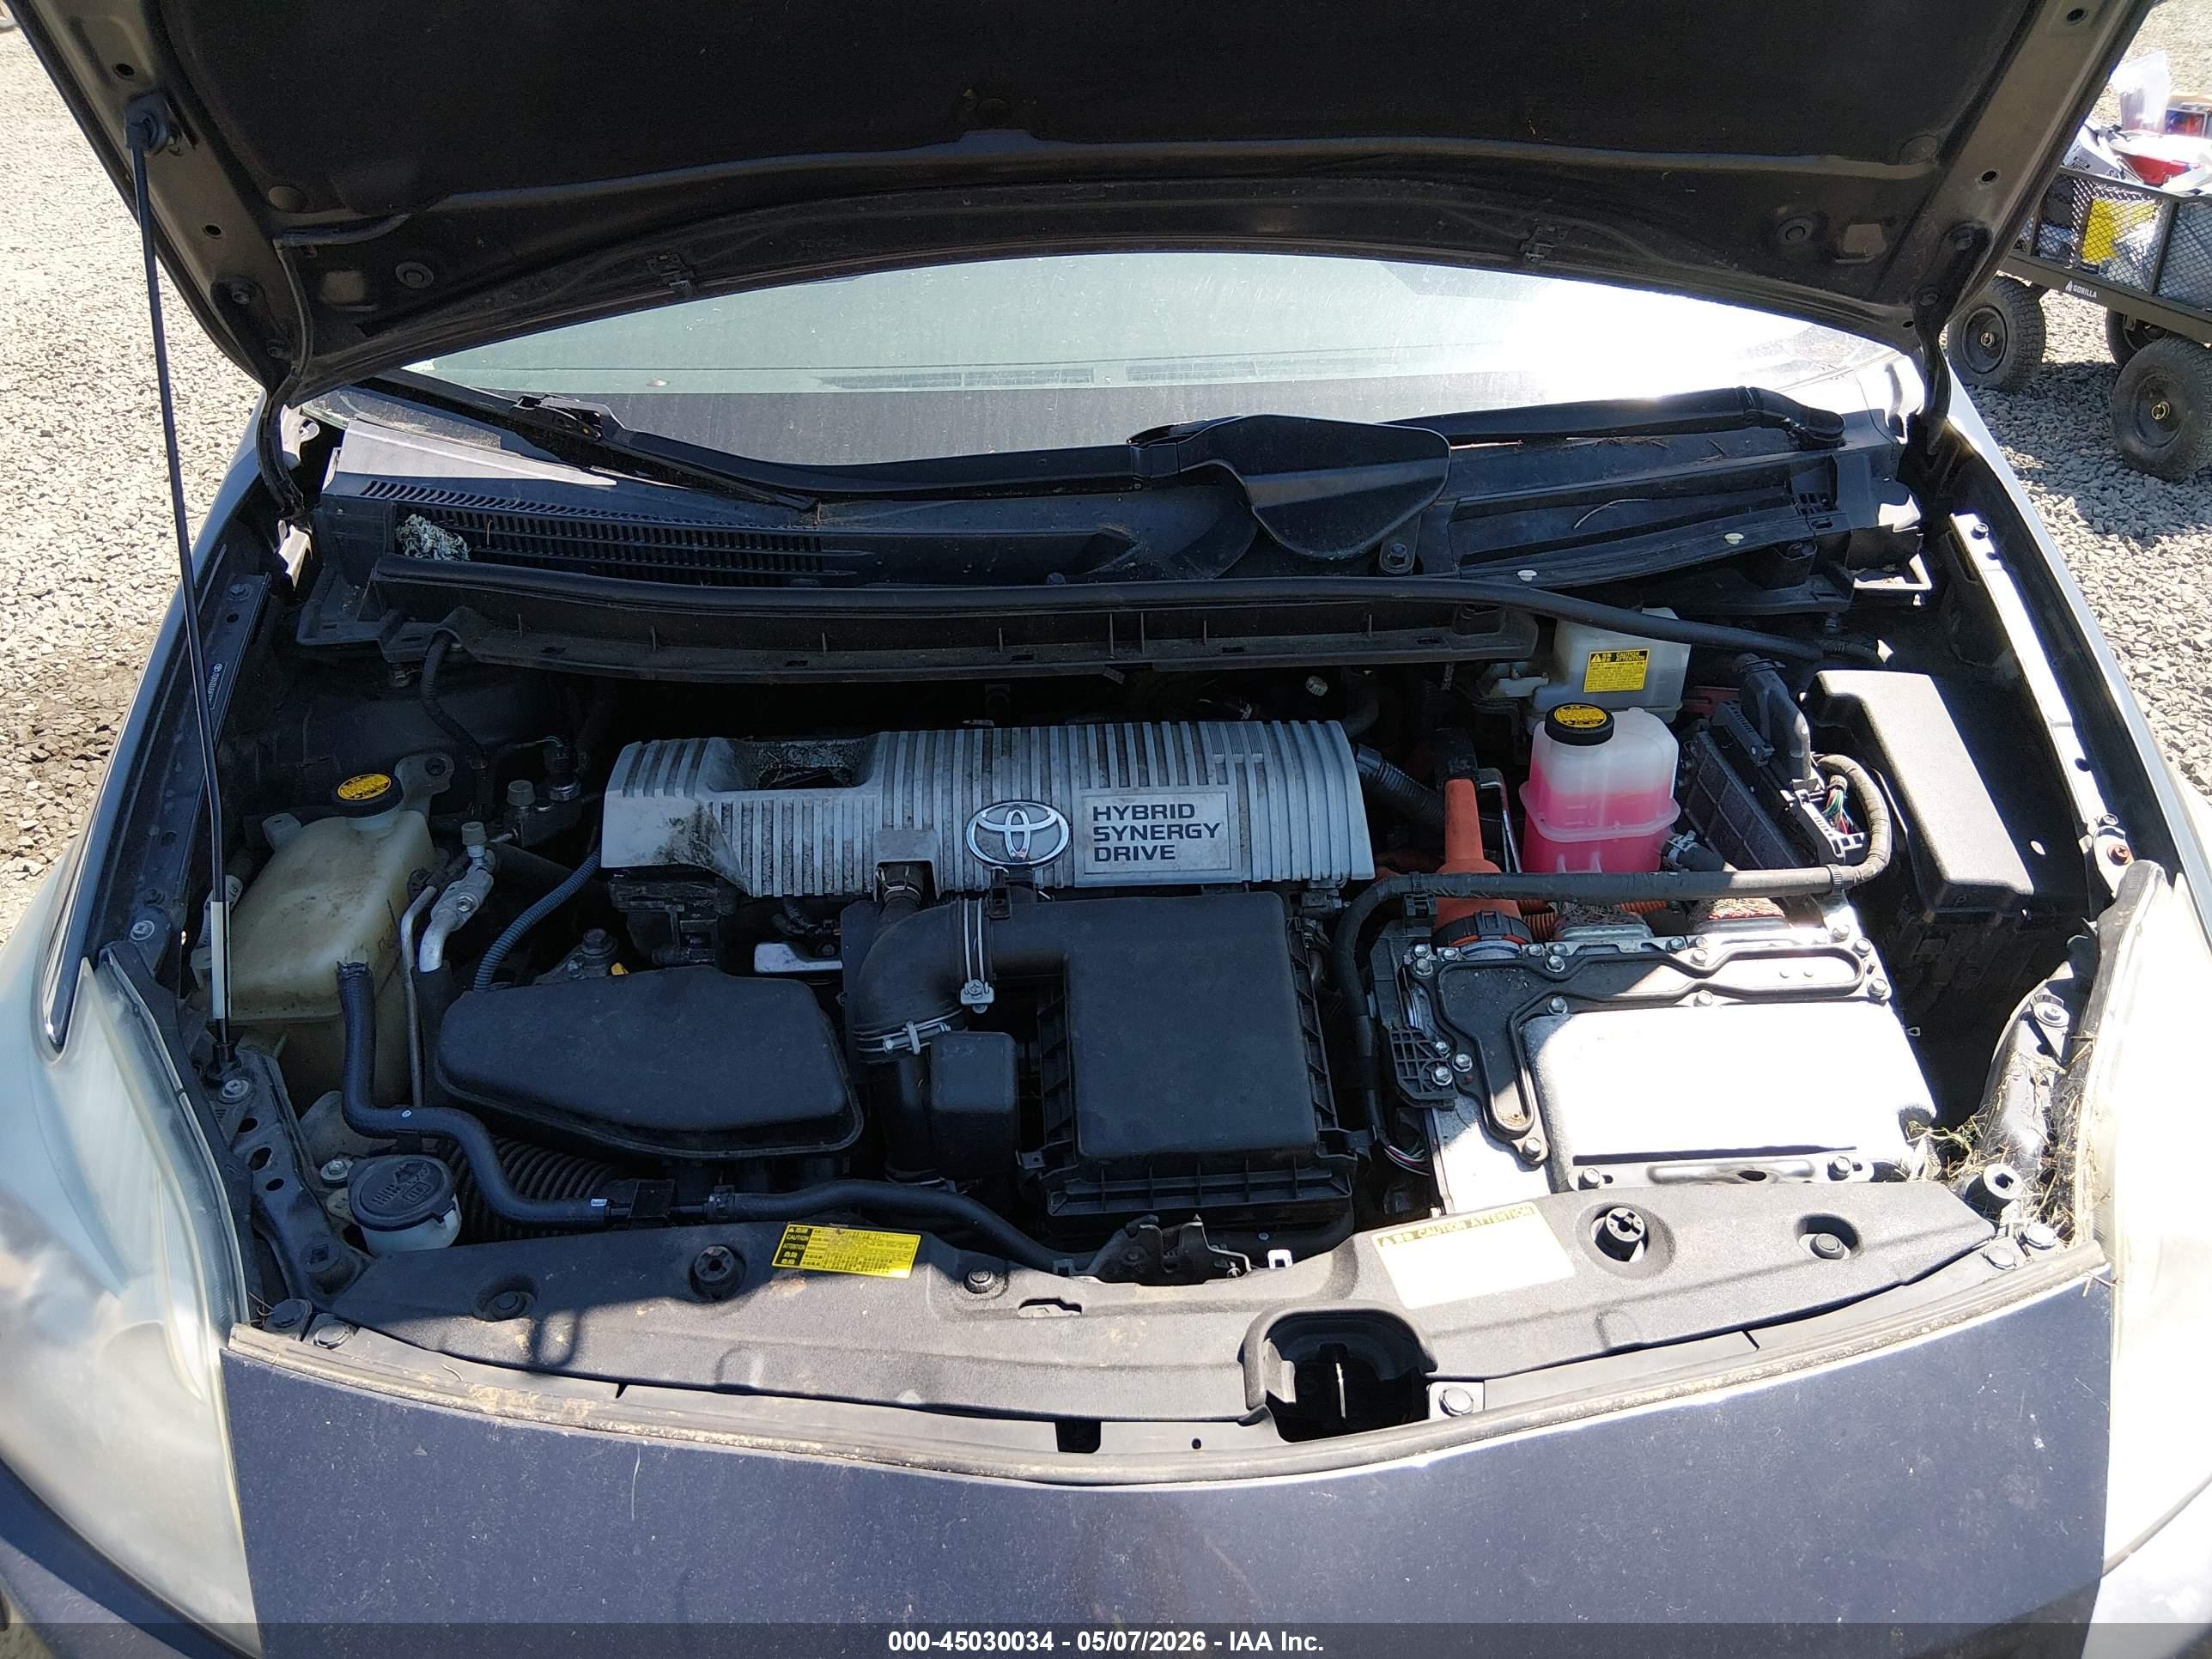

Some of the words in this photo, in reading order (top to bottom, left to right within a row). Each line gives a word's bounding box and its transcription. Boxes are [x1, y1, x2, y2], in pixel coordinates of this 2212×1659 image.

[2073, 284, 2097, 298] GORILLA
[1093, 803, 1195, 822] HYBRID
[1093, 823, 1221, 842] SYNERGY
[1094, 845, 1176, 862] DRIVE
[1418, 1219, 1467, 1239] CAUTION
